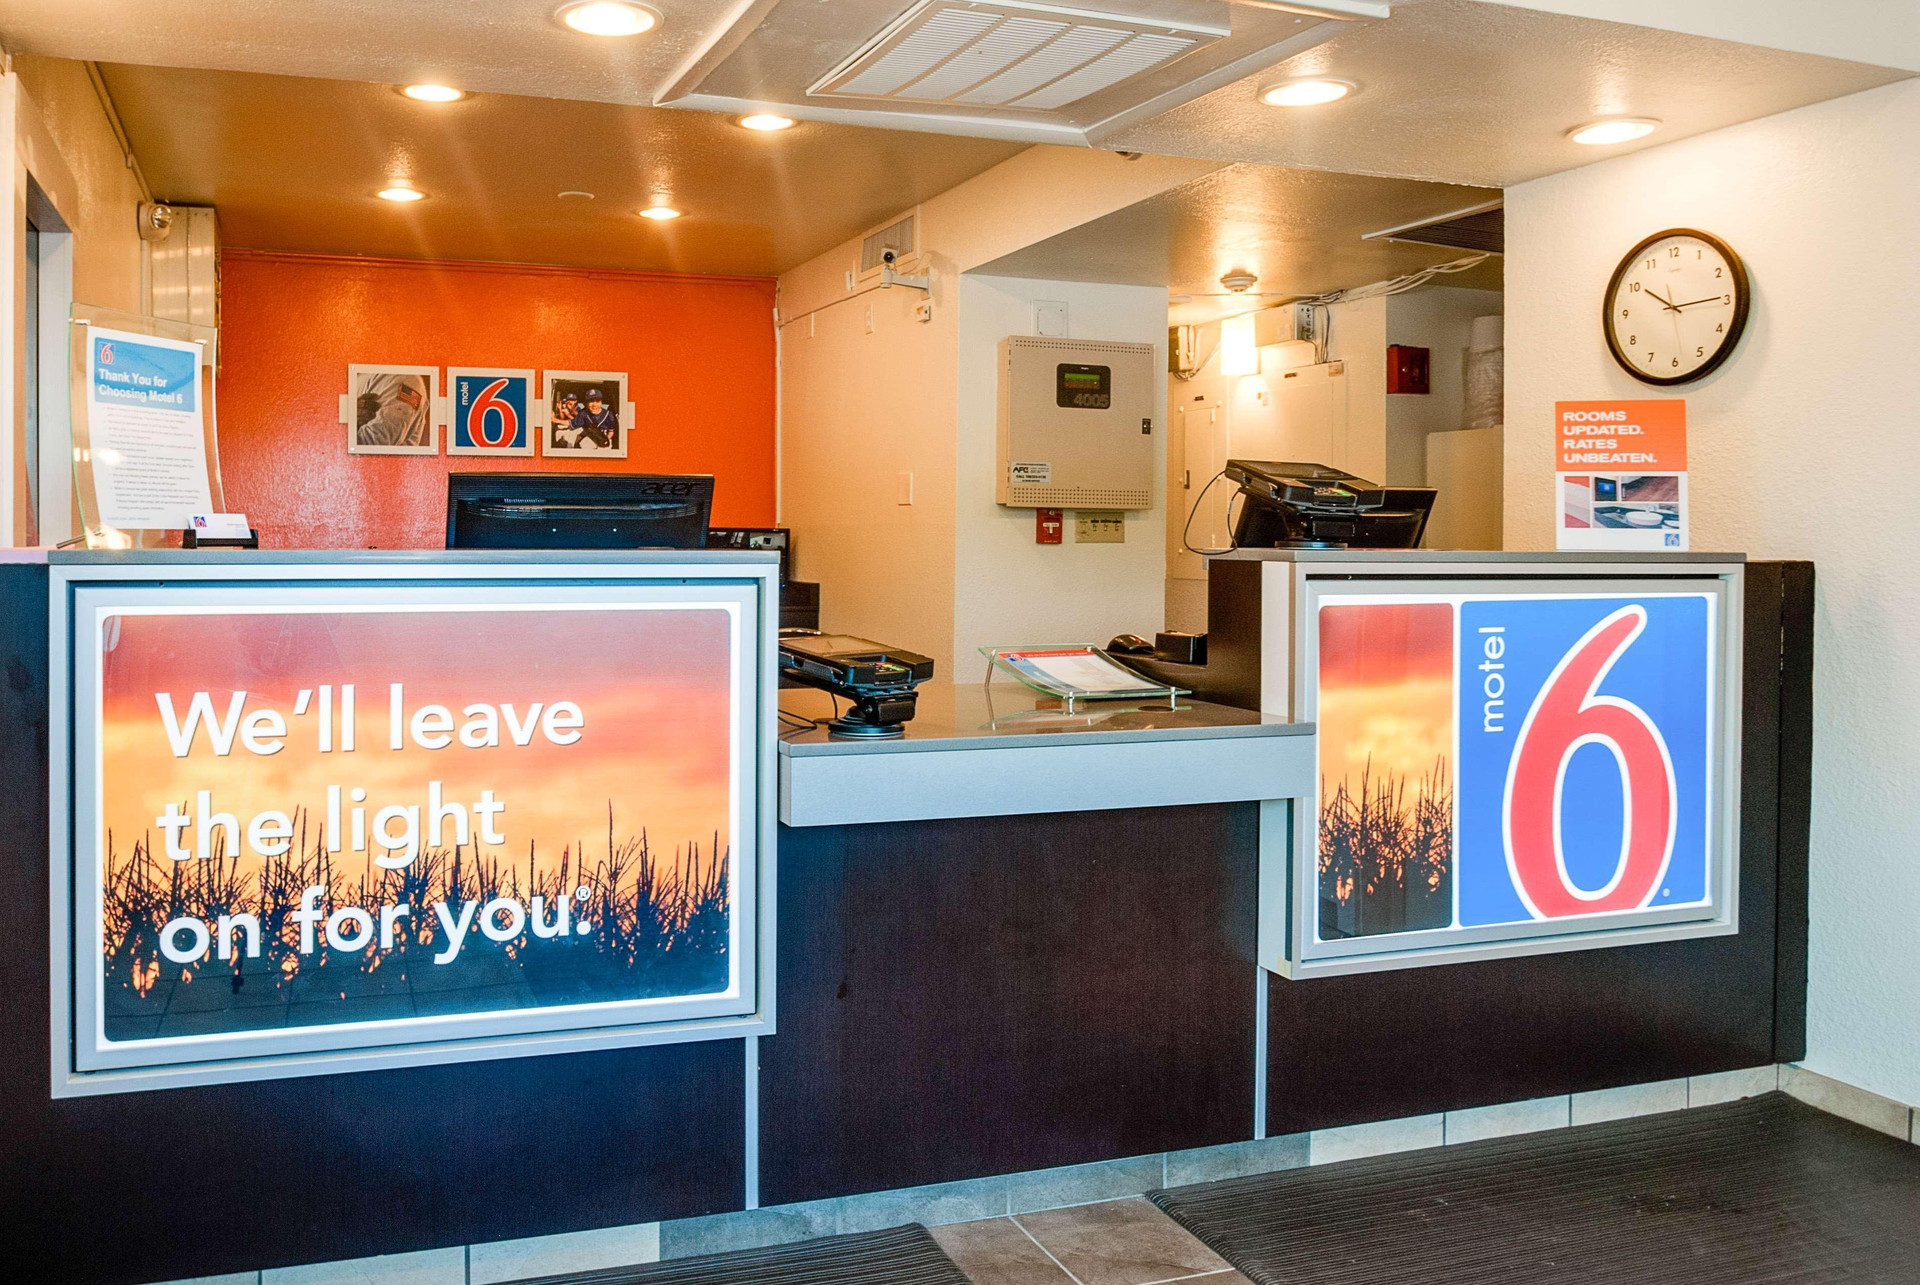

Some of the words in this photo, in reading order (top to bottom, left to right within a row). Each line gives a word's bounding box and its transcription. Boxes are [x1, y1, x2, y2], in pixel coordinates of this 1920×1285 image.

[1668, 246, 1680, 259] 12
[1696, 250, 1701, 260] 1
[1646, 259, 1656, 270] 11
[1715, 267, 1722, 278] 2
[1629, 282, 1641, 293] 10
[1723, 294, 1731, 306] 3
[1622, 309, 1629, 320] 9
[1715, 323, 1723, 334] 4
[1629, 335, 1637, 346] 8
[1648, 352, 1655, 363] 7
[1696, 346, 1704, 358] 5
[1671, 357, 1679, 368] 6
[98, 367, 131, 384] Thank
[131, 372, 152, 386] You
[153, 375, 168, 389] for
[98, 384, 147, 403] Choosing
[148, 389, 175, 404] Motel
[176, 393, 184, 405] 6
[461, 381, 469, 406] motel
[1073, 392, 1109, 408] 4005
[467, 377, 519, 448] 6
[1562, 410, 1627, 422] ROOMS
[1562, 424, 1645, 436] UPDATED.
[1562, 438, 1618, 450] RATES
[1563, 452, 1658, 464] UNBEATEN.
[640, 481, 701, 497] acer
[1477, 625, 1506, 734] motel
[389, 683, 585, 751] leave
[1501, 603, 1679, 920] 6
[155, 789, 294, 862] the
[326, 780, 506, 870] light
[158, 910, 261, 965] on
[291, 885, 411, 955] for
